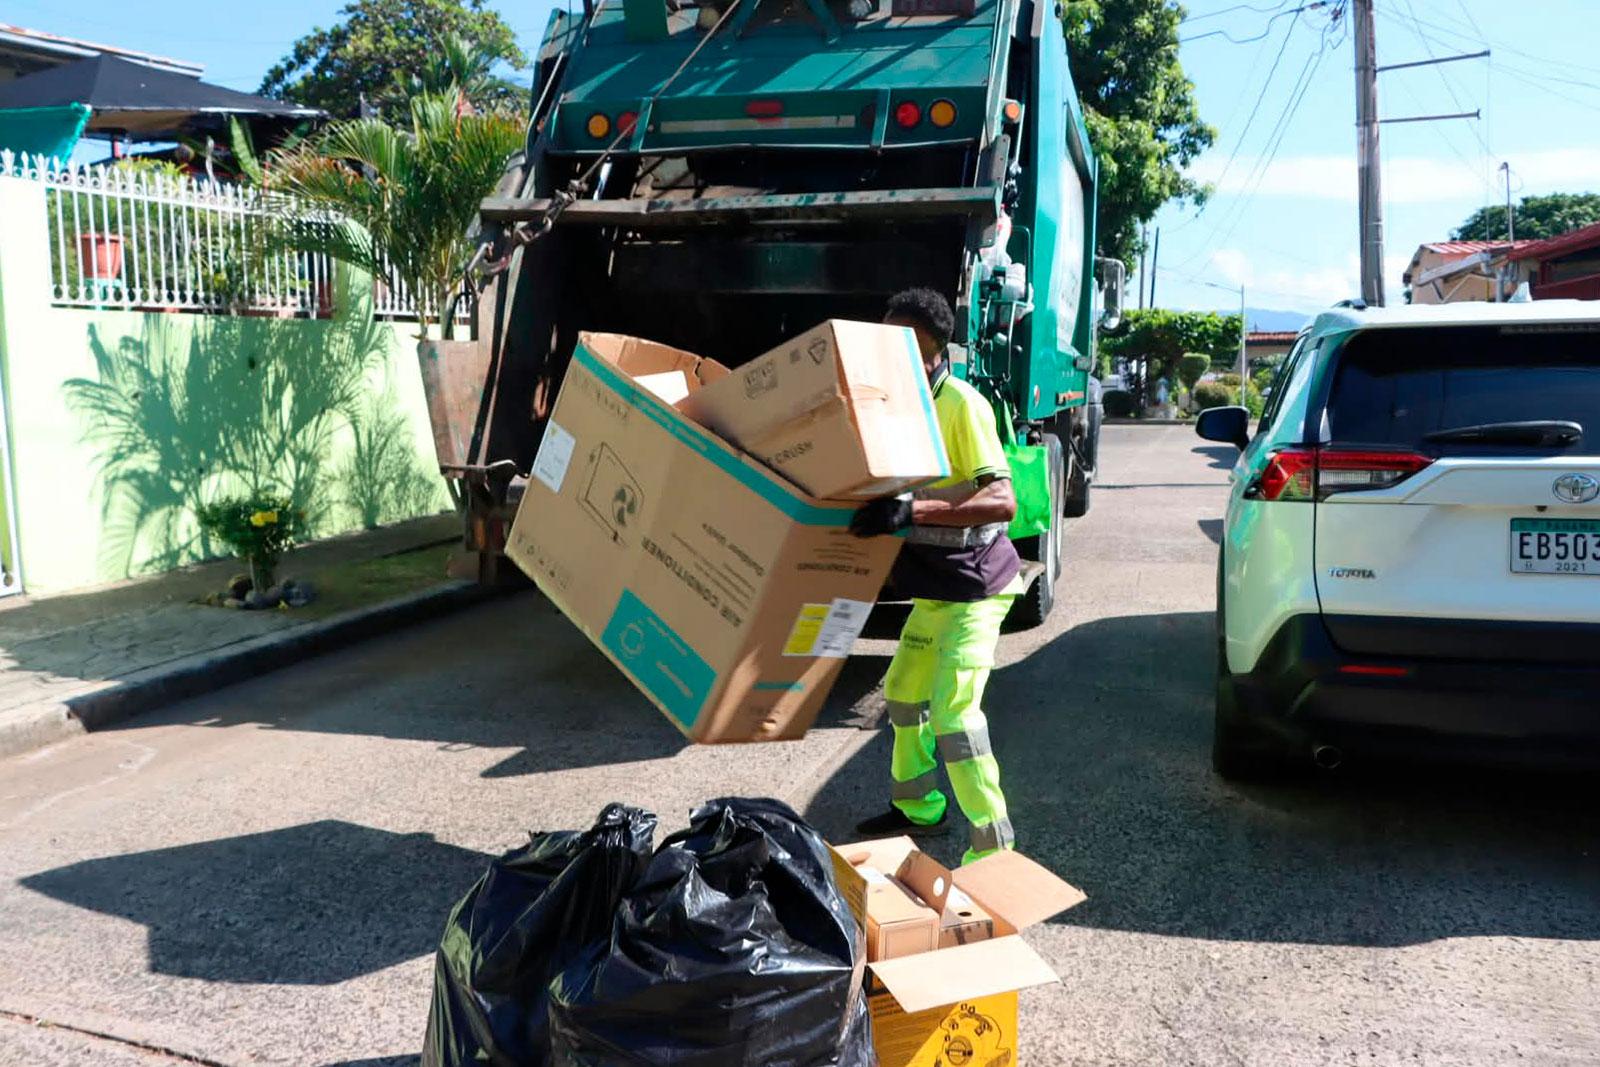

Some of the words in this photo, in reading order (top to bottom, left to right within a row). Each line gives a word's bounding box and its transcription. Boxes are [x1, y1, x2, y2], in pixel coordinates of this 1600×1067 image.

[1519, 532, 1600, 561] EB503
[641, 536, 719, 609] CONDITIONER
[1328, 566, 1377, 579] TOYOTA
[1555, 562, 1586, 572] 2021
